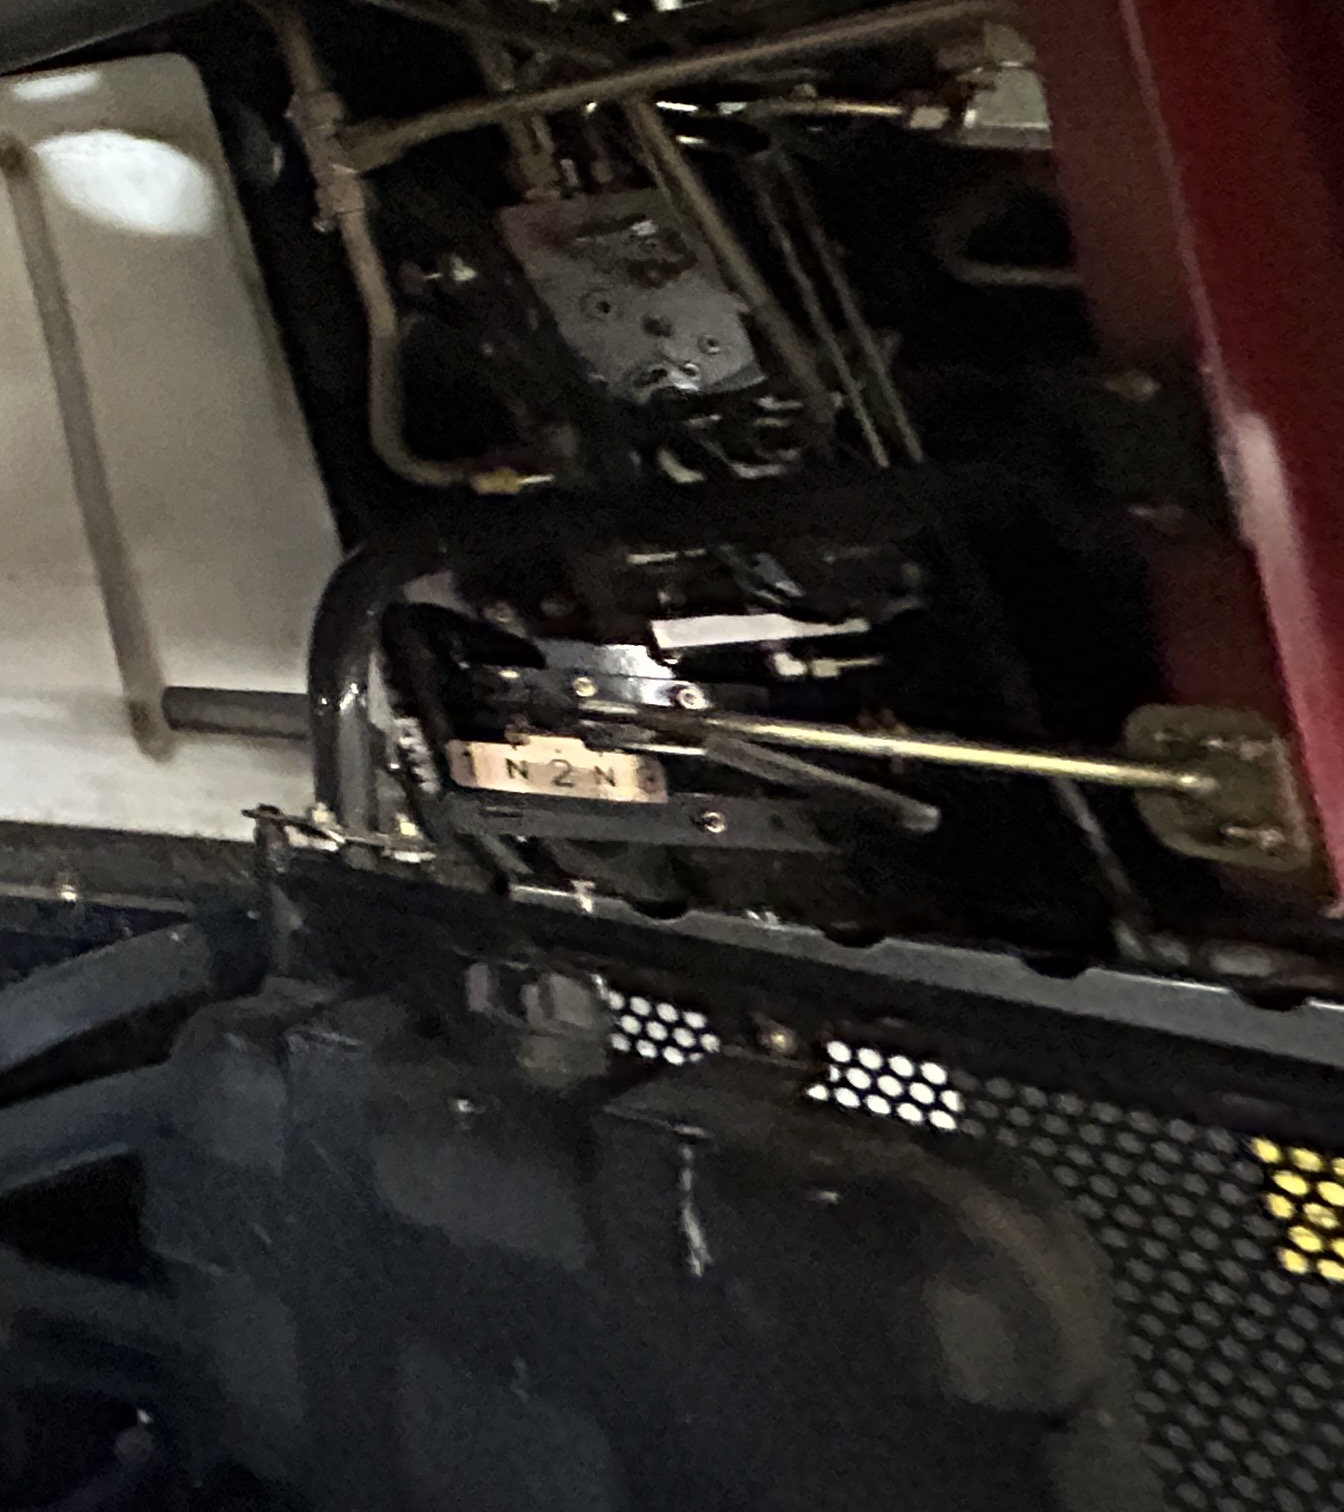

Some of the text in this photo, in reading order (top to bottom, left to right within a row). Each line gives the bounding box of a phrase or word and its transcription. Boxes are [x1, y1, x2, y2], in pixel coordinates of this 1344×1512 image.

[505, 757, 529, 780] N
[550, 758, 575, 788] 2
[594, 764, 616, 787] N
